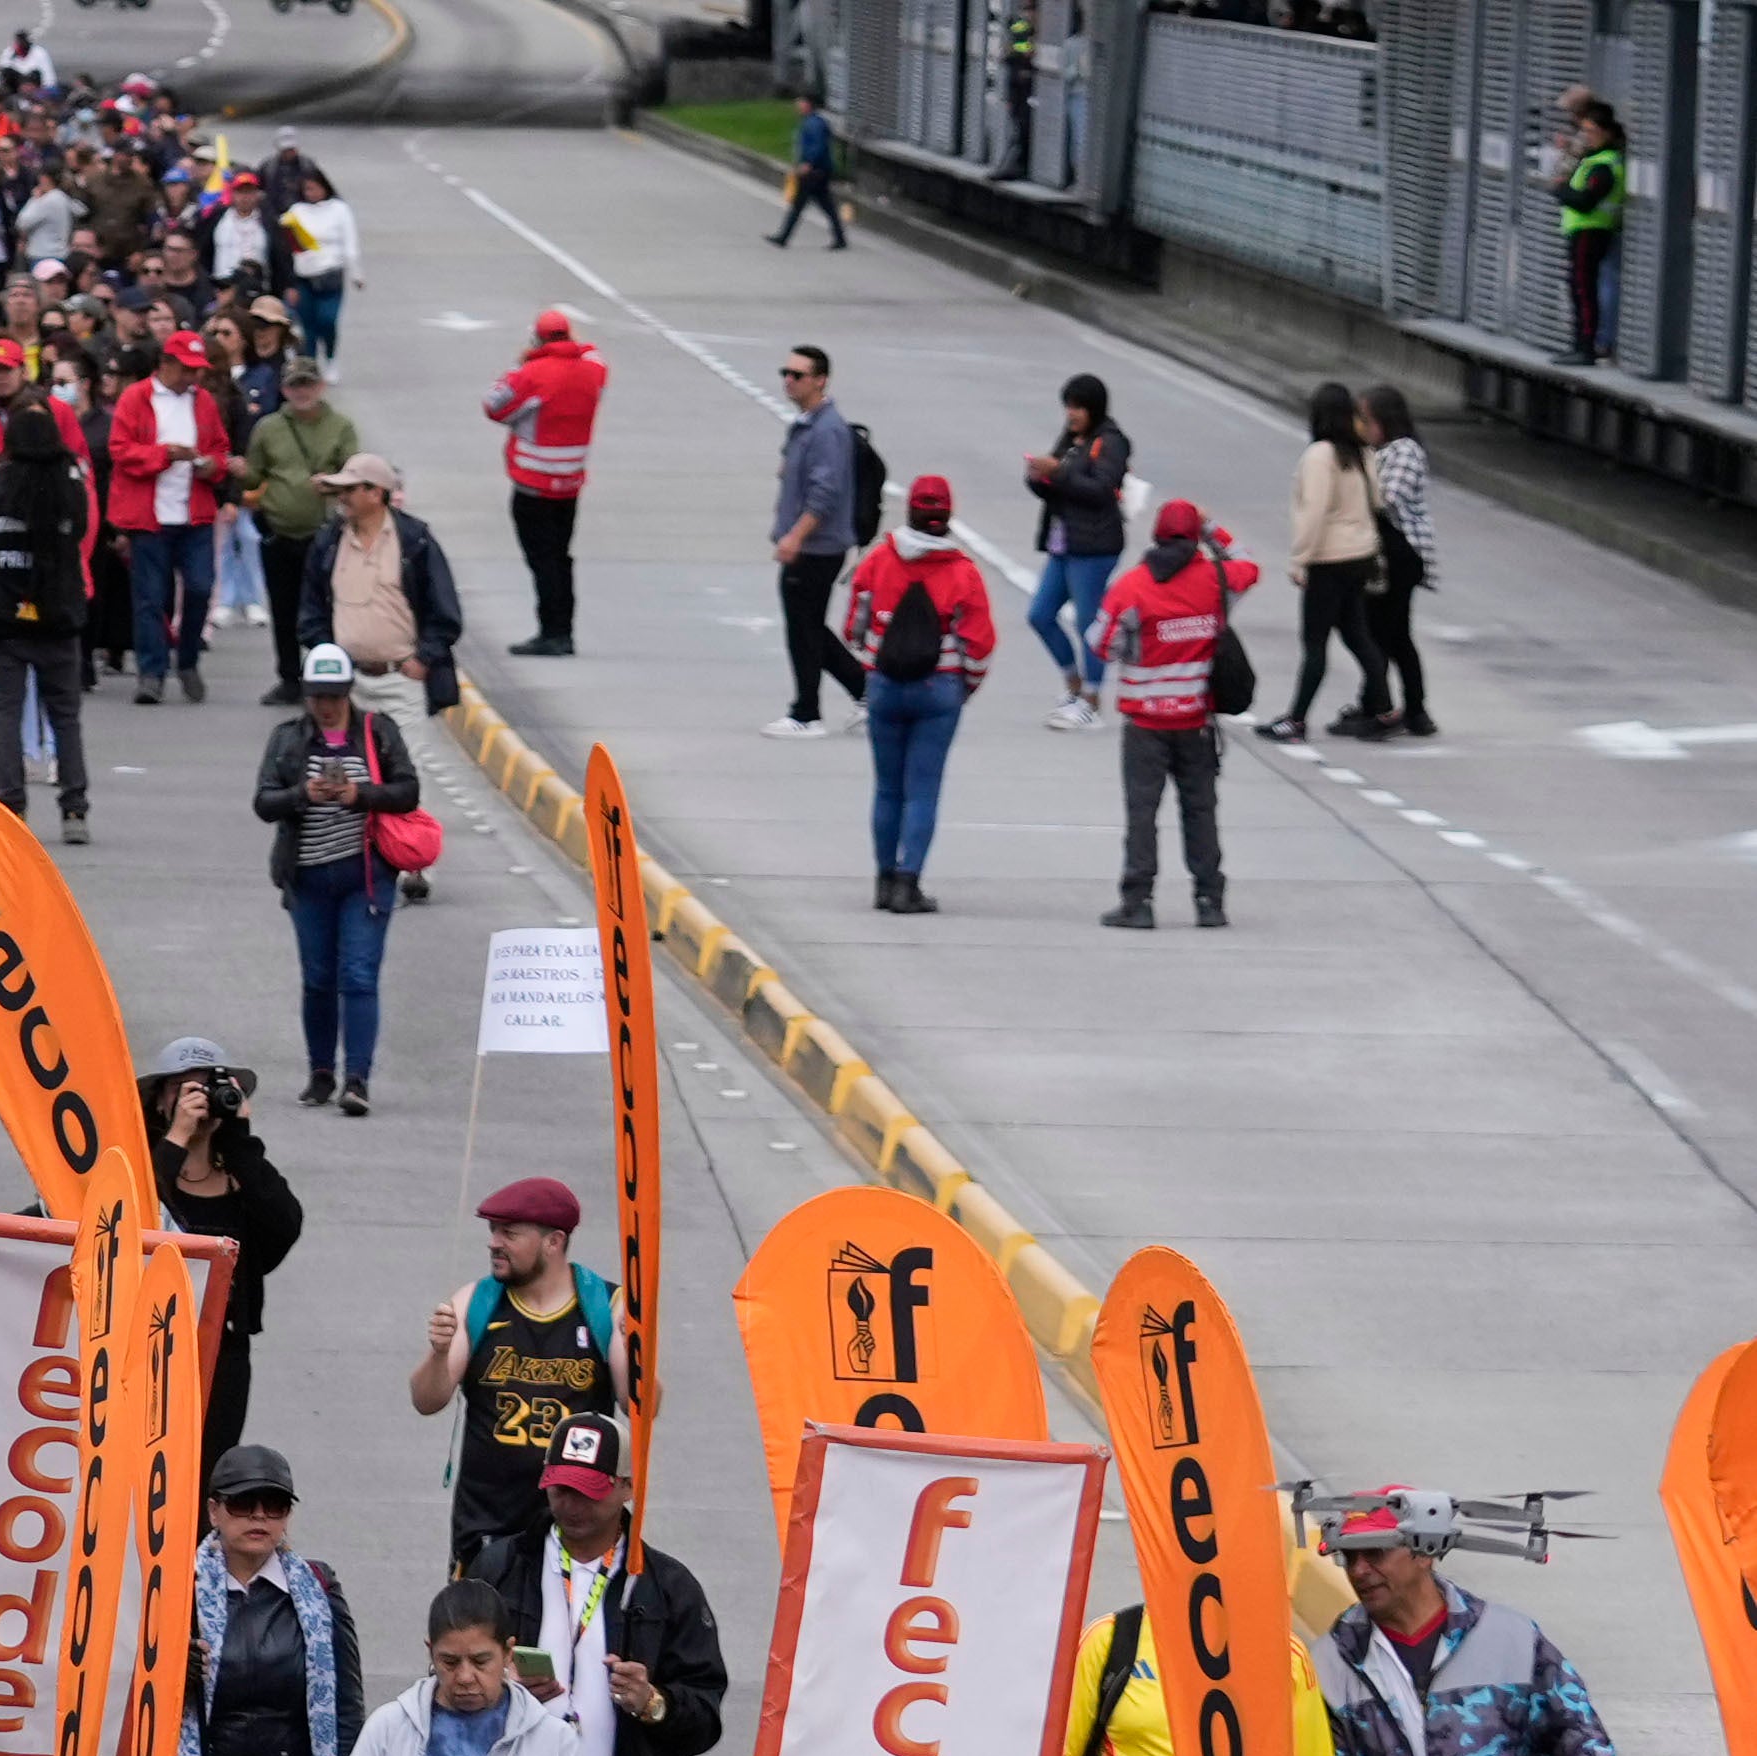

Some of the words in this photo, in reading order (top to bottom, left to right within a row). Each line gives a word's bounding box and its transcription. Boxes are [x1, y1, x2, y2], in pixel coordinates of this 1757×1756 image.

[543, 944, 599, 958] EVALUA
[478, 1345, 596, 1391] LAKERS
[493, 1391, 570, 1448] 23
